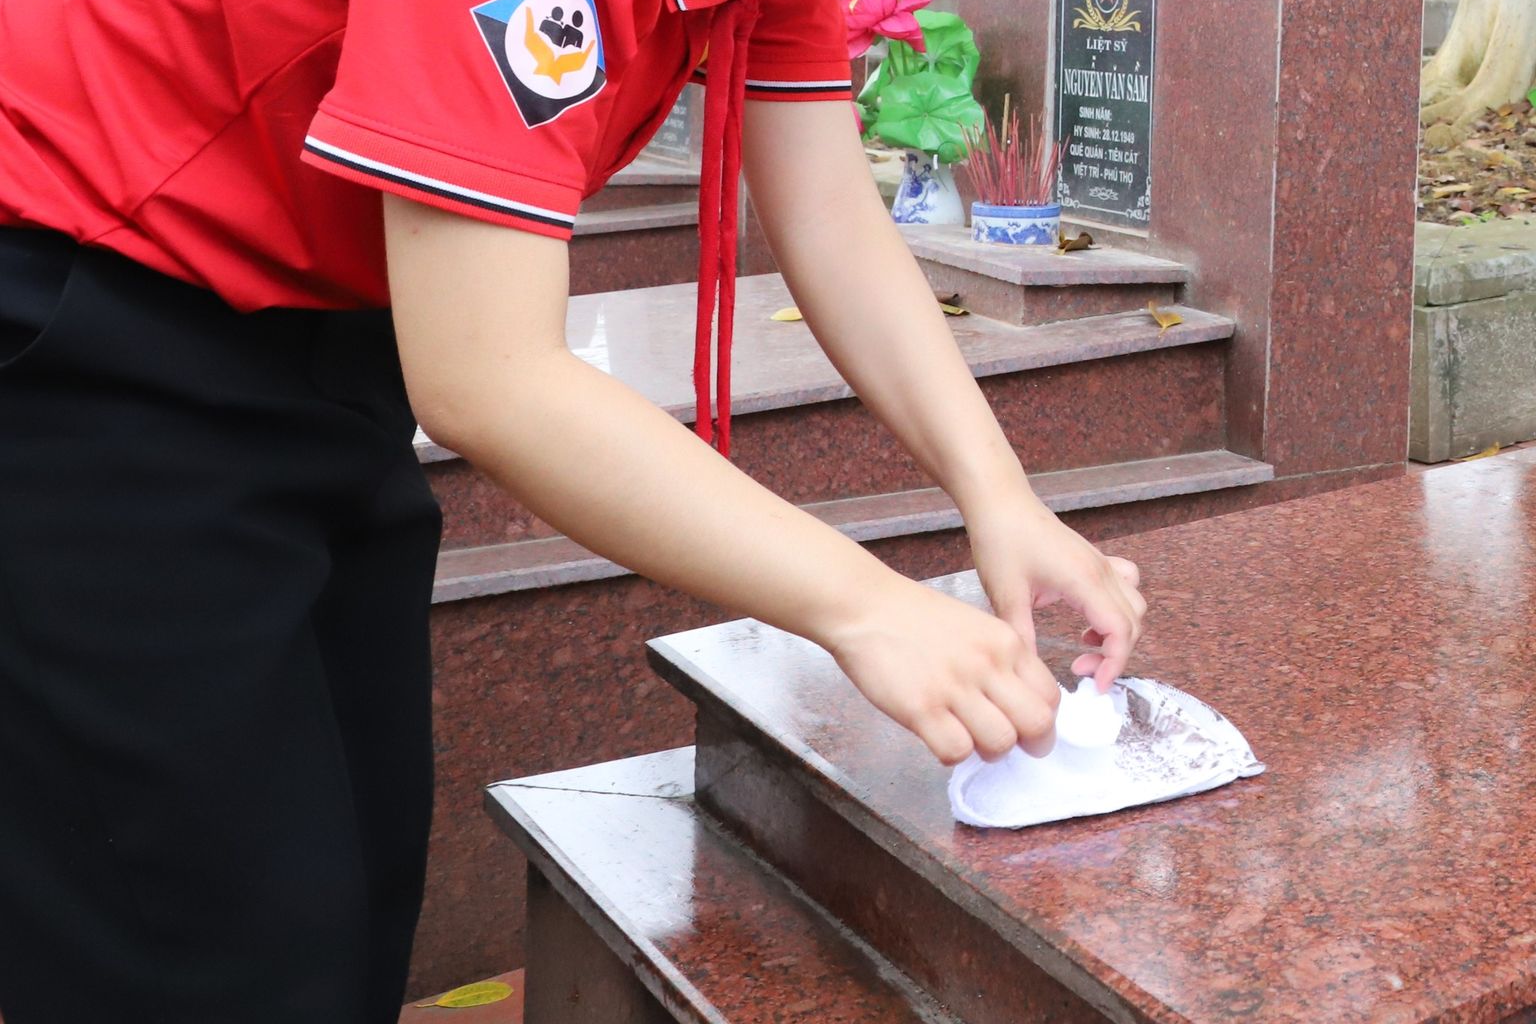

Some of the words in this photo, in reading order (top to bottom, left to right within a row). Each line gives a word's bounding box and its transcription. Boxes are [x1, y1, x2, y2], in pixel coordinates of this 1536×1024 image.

[1086, 36, 1112, 53] LIỆT
[1105, 65, 1125, 100] VĂN
[1079, 106, 1094, 118] SINH
[1073, 125, 1083, 137] HY
[1084, 126, 1101, 139] SINH:
[1070, 142, 1084, 156] QUÊ
[1084, 144, 1103, 159] QUÁN
[1073, 162, 1088, 179] VIỆT
[1089, 163, 1100, 179] TRÌ
[1103, 166, 1118, 181] PHÚ
[1119, 170, 1134, 190] THỌ
